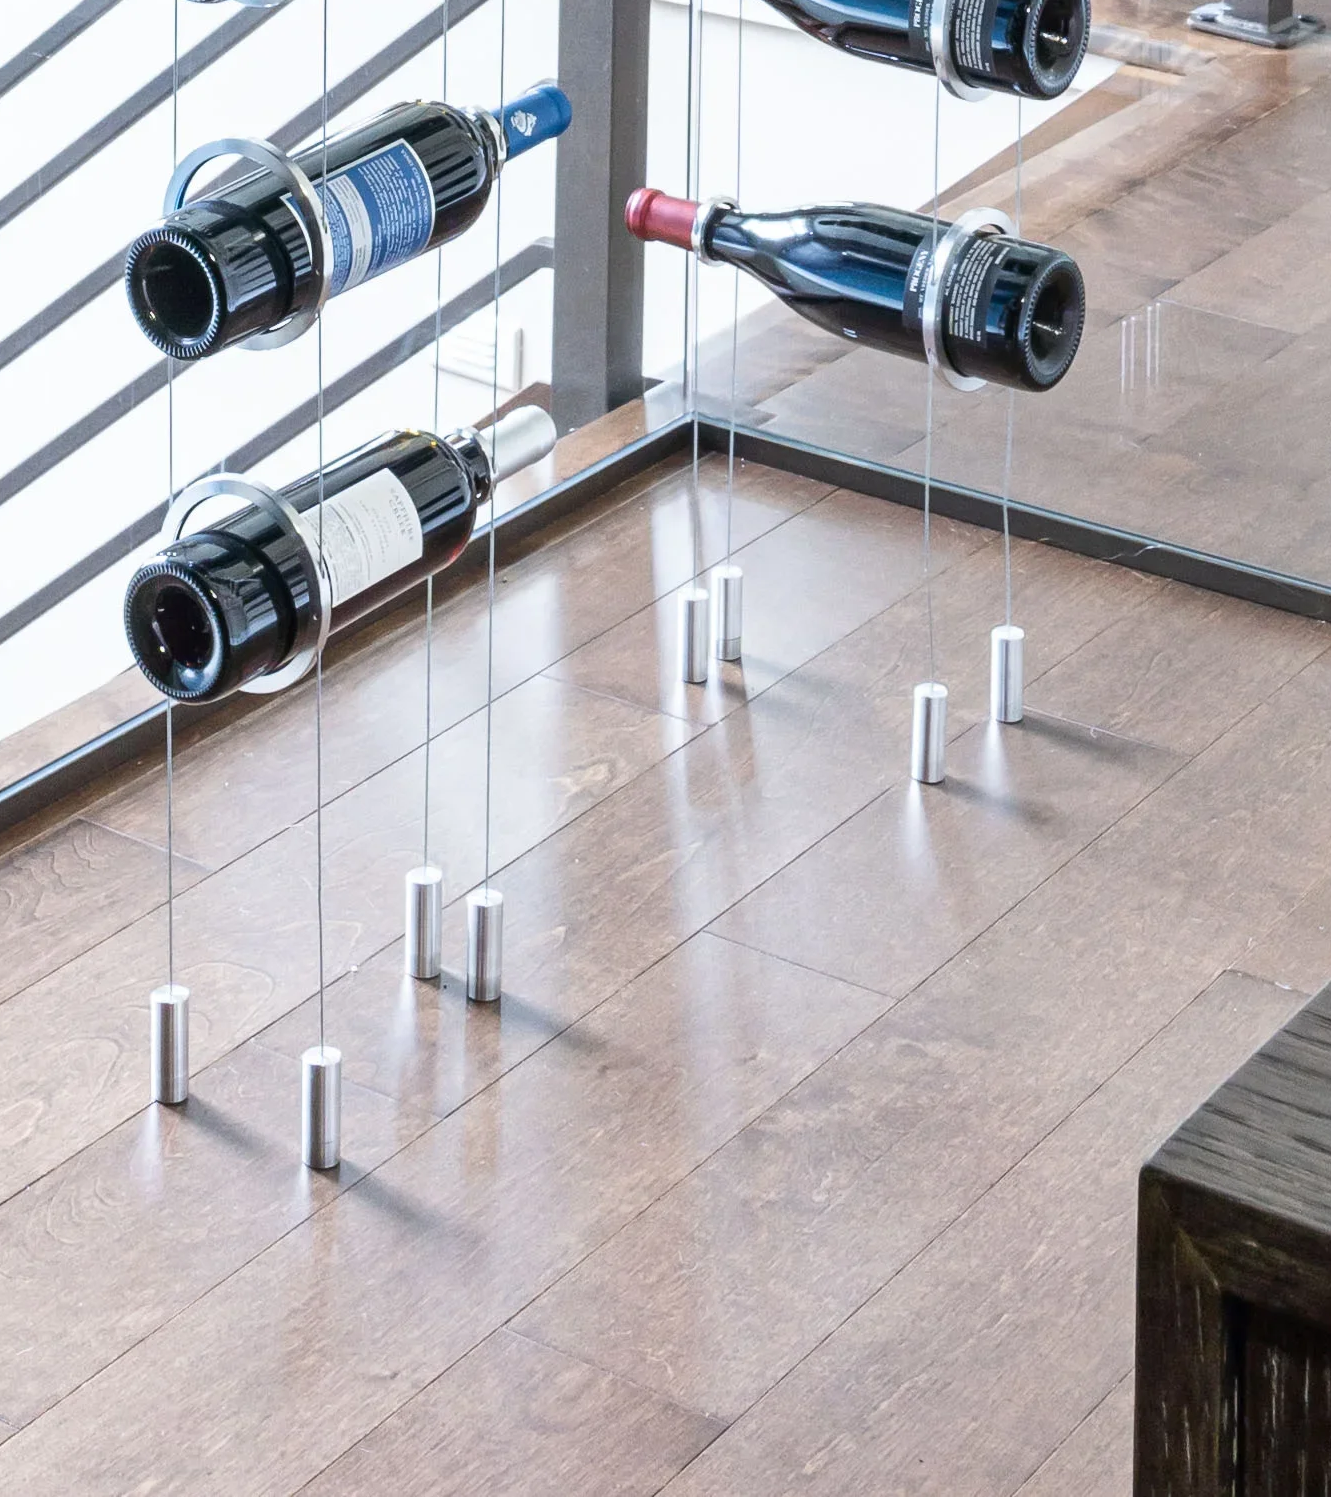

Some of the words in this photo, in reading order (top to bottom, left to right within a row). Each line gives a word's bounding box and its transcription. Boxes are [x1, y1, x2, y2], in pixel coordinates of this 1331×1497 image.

[411, 167, 422, 184] CON
[418, 185, 426, 197] UN
[909, 249, 928, 292] PROGENY
